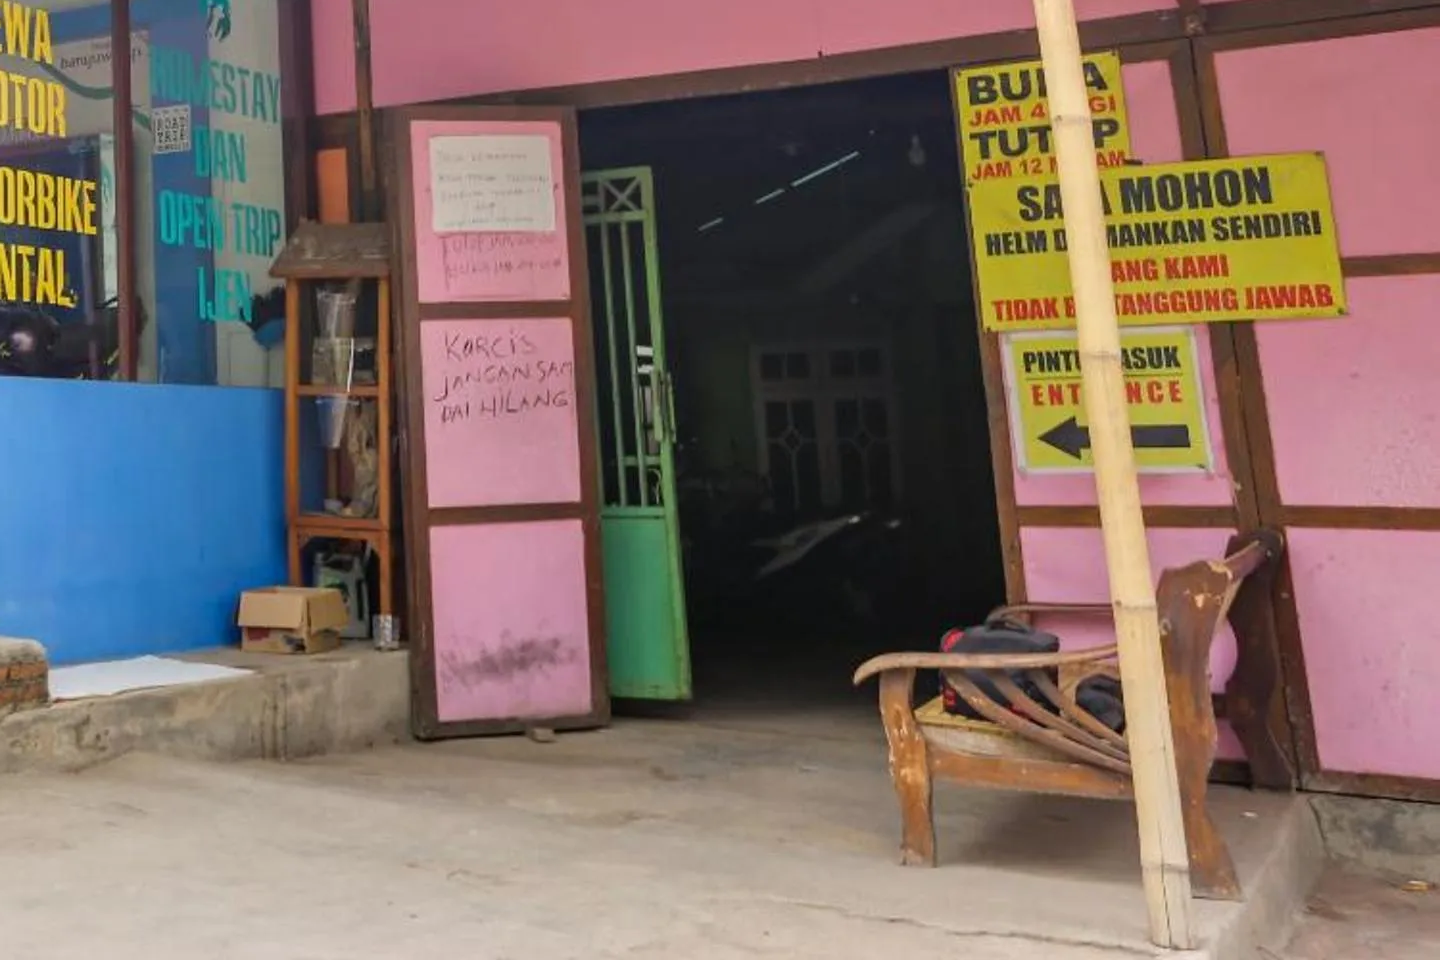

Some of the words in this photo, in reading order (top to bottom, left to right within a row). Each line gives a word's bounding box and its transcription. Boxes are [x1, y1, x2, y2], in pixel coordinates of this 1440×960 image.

[149, 43, 281, 124] HOMESTAY
[969, 106, 1022, 128] JAM
[1030, 103, 1046, 121] 4
[194, 125, 248, 183] DAN
[968, 118, 1120, 160] TUTP
[971, 160, 1013, 181] JAM
[1019, 157, 1043, 177] 12
[1119, 166, 1274, 215] MOHON
[159, 189, 225, 254] OPEN
[232, 203, 282, 258] TRIP
[985, 229, 1048, 257] HELM
[1053, 215, 1206, 255] DMANKAN
[1213, 210, 1322, 242] SENDIRI
[1164, 253, 1229, 281] KAMI
[196, 266, 253, 323] IJEN
[992, 295, 1060, 323] TIDAK
[1063, 288, 1239, 319] BTANGGUNG
[1244, 284, 1335, 312] JAWAB
[1120, 345, 1181, 370] ASUK
[480, 390, 569, 418] HILANG
[1031, 380, 1184, 406] ENTNCE
